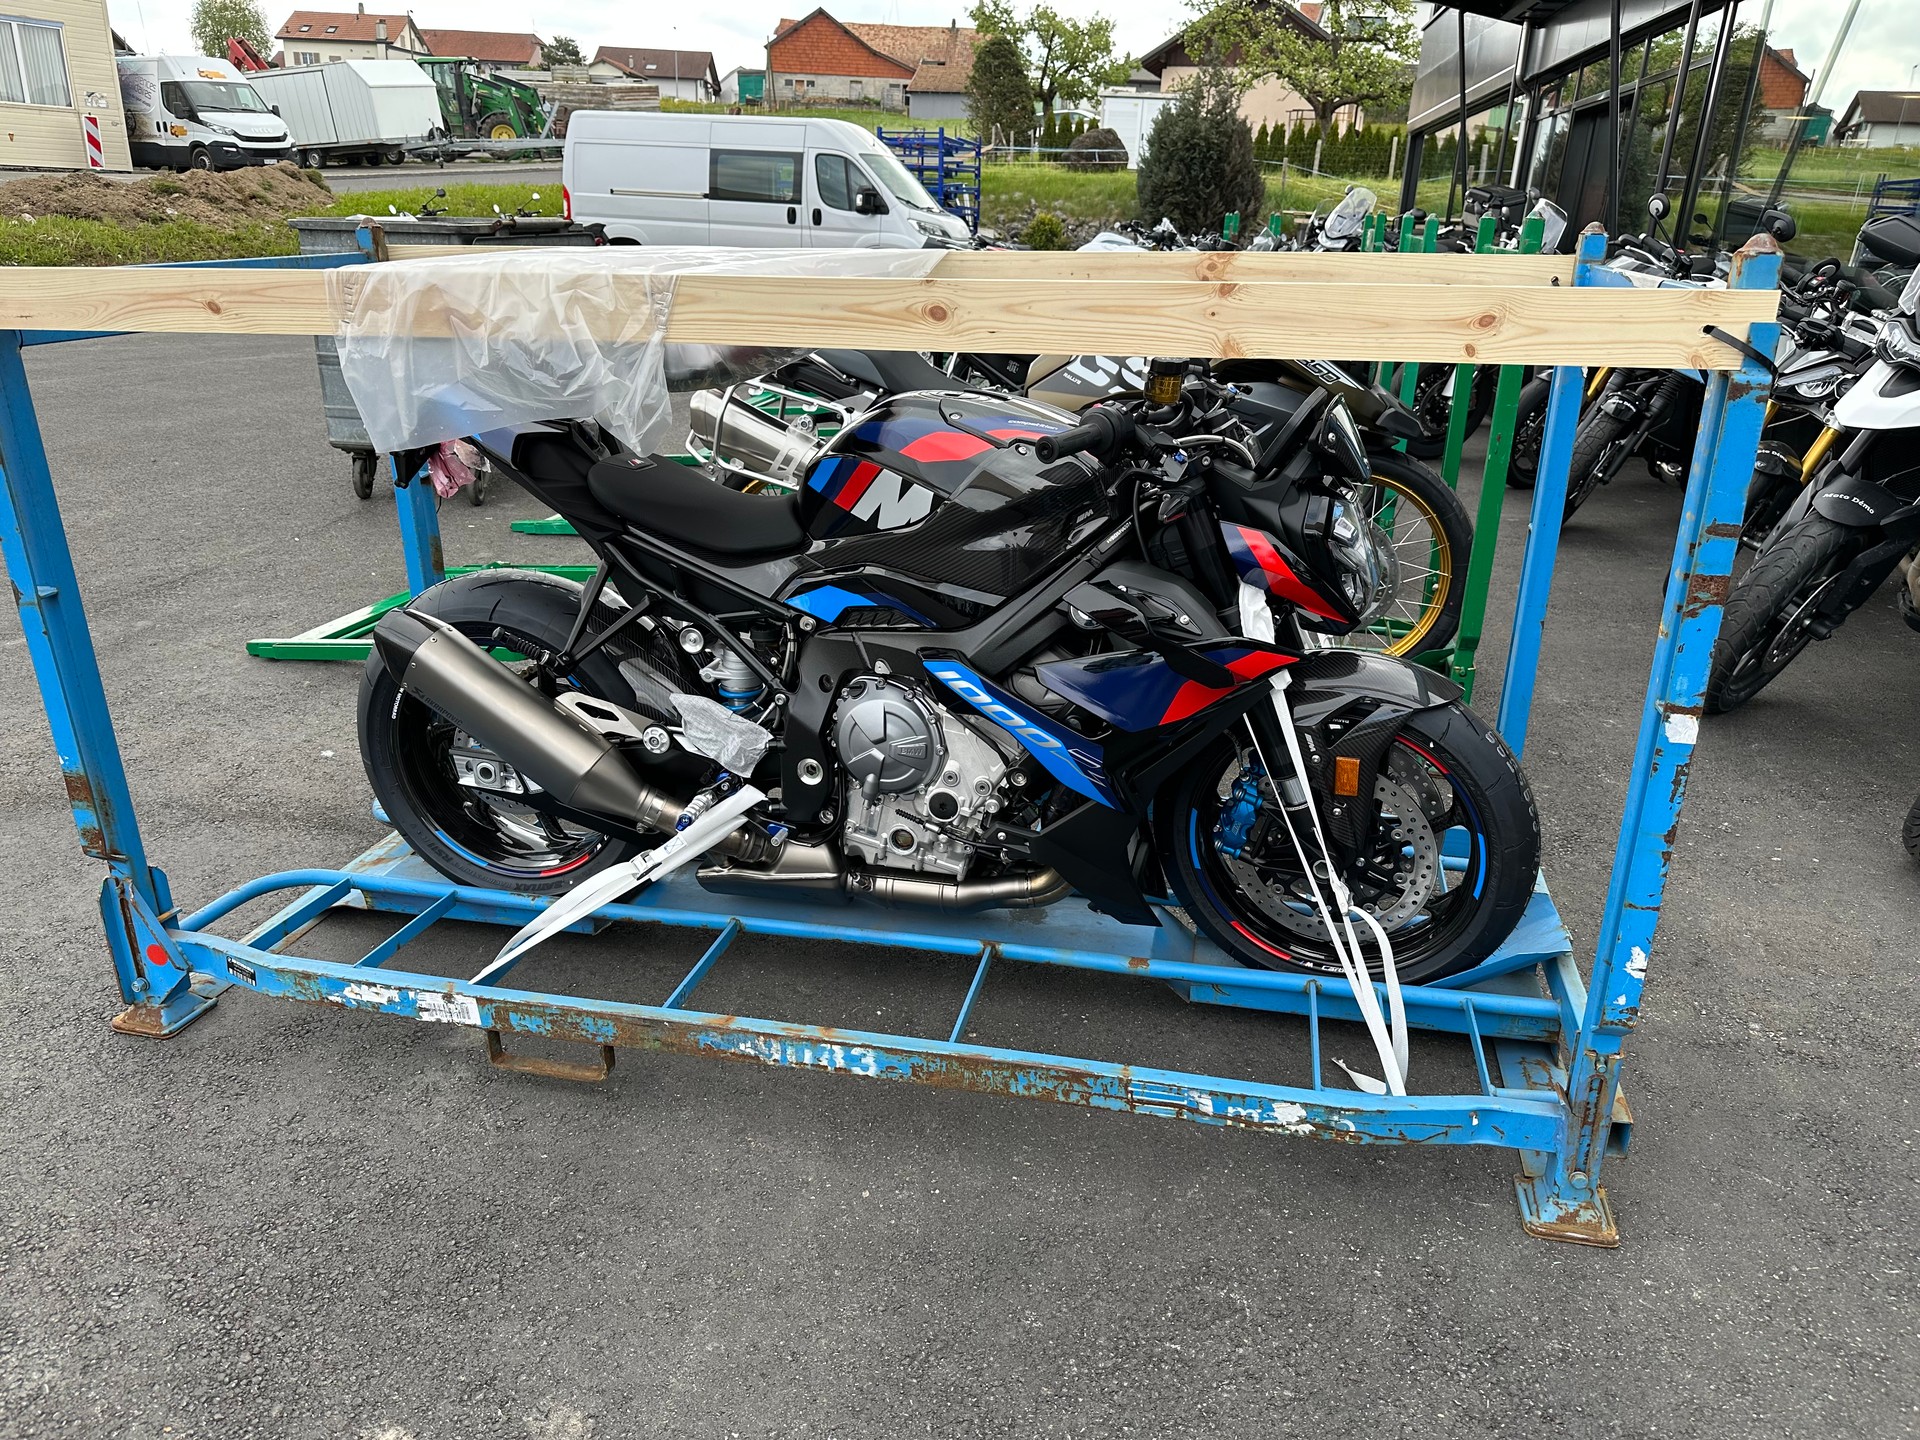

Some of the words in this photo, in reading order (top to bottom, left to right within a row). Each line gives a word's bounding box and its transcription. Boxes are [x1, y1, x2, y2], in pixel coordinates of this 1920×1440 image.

[1008, 419, 1059, 431] competition
[1822, 493, 1850, 501] Moto
[1851, 496, 1875, 515] Démo
[934, 671, 1062, 748] 1000
[901, 747, 922, 756] BMW
